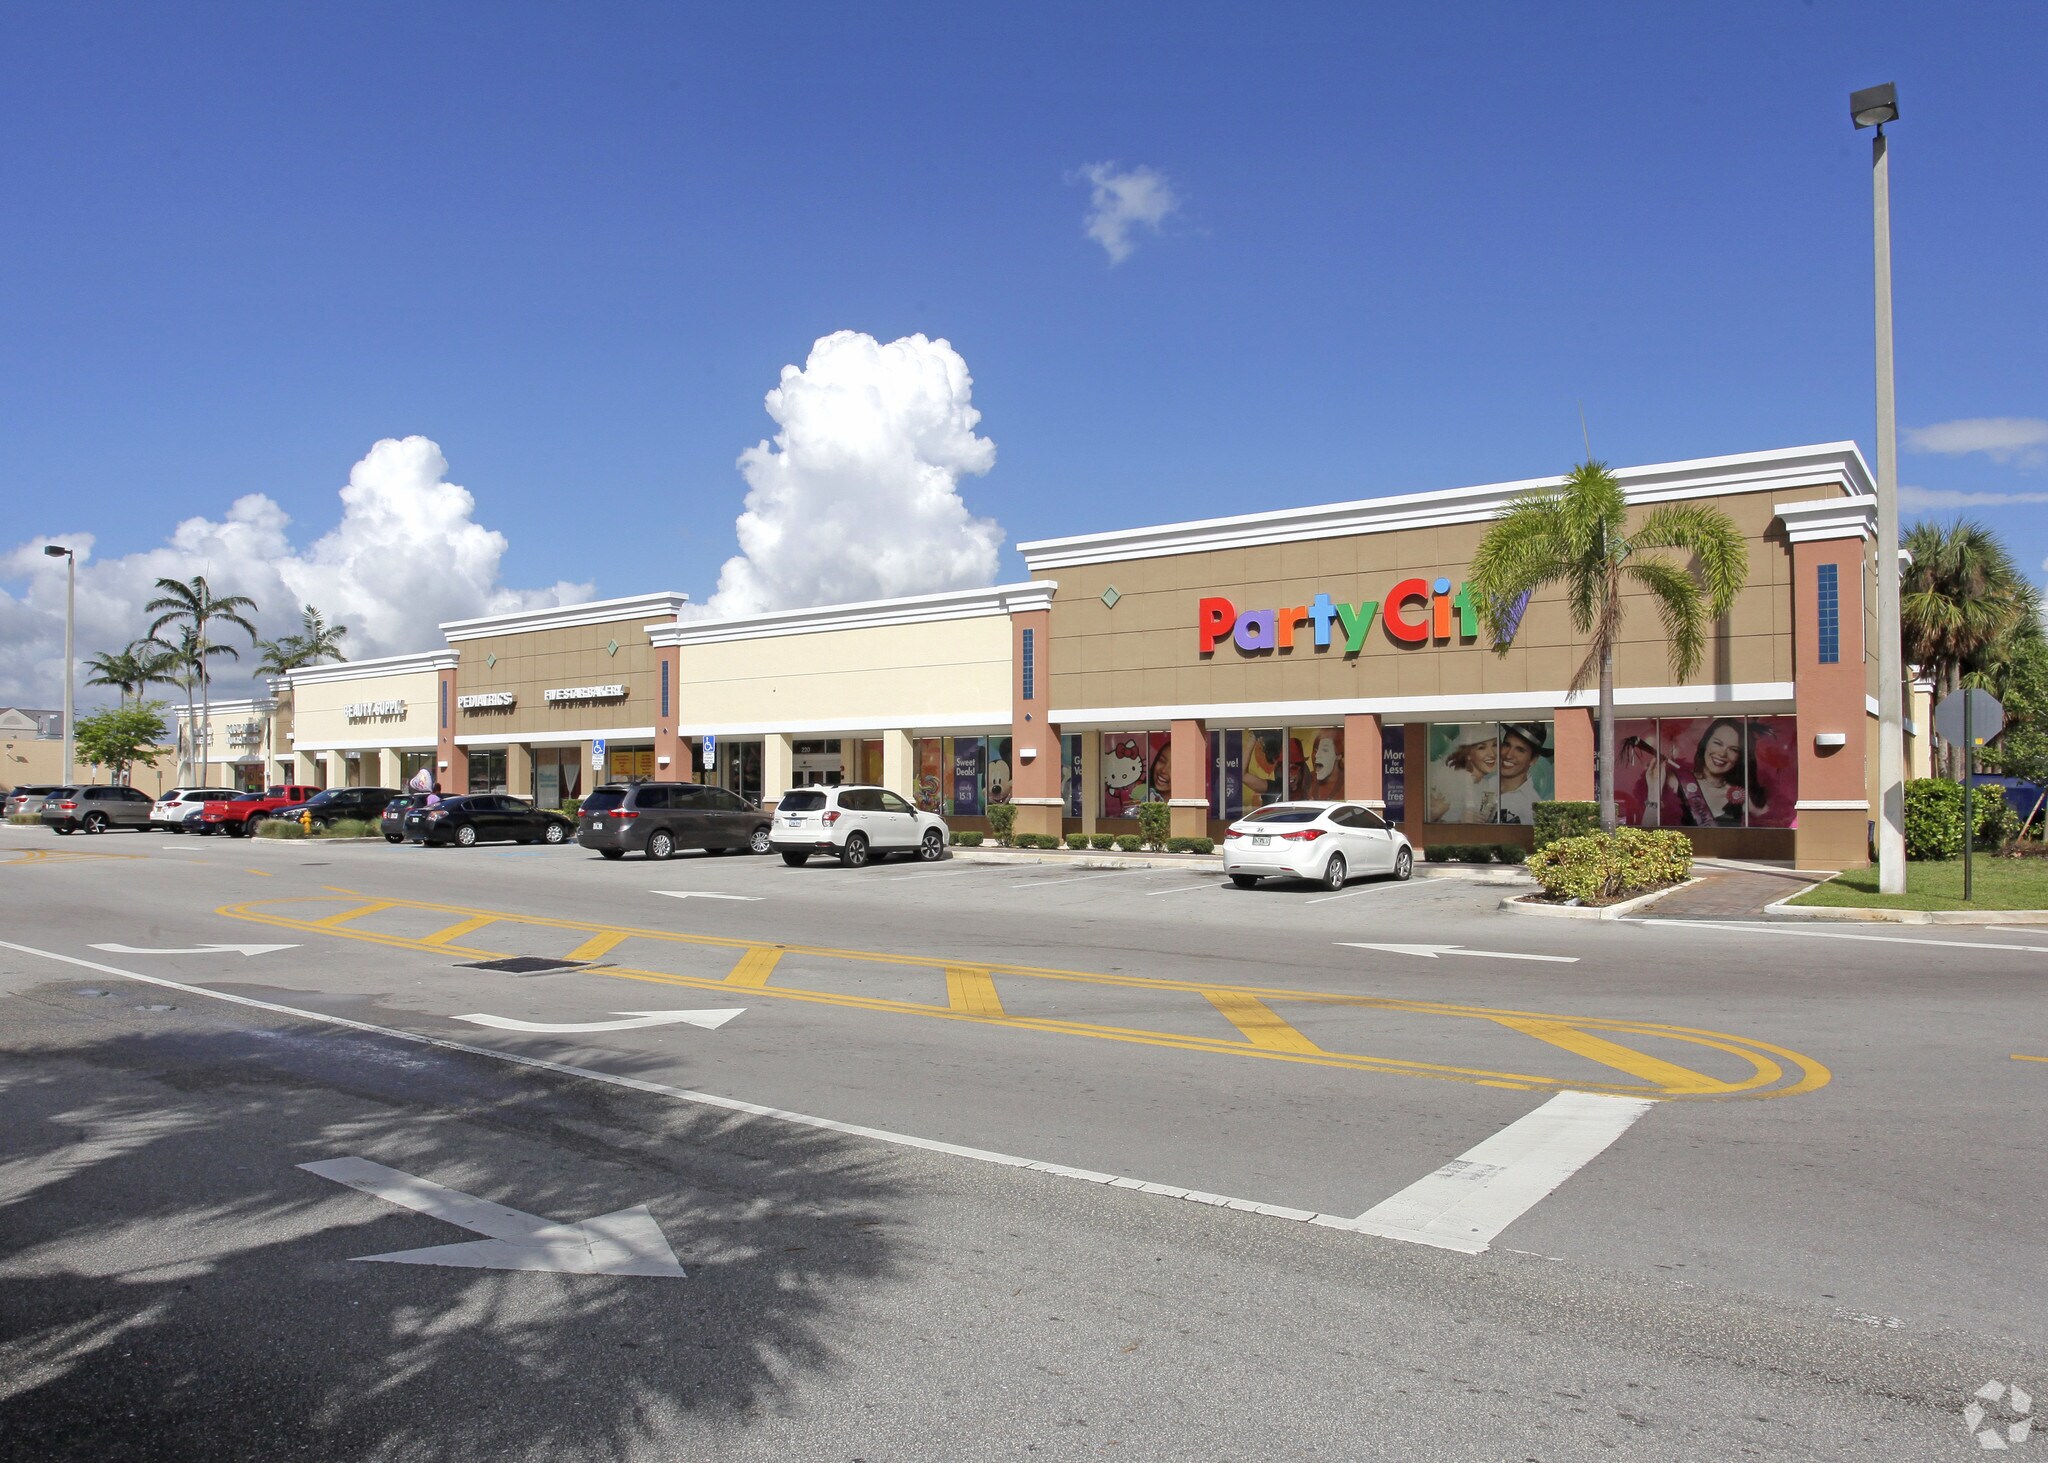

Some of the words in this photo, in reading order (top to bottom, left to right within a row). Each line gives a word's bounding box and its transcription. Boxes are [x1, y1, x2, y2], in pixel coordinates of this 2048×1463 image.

[1199, 593, 1379, 652] Party
[457, 692, 513, 708] PEDIATRICS
[344, 702, 374, 717] BEAUTY
[374, 700, 405, 715] SUPPLY
[956, 758, 976, 766] Sweet
[1216, 758, 1239, 768] Sve!
[956, 768, 976, 776] Deals!
[1385, 764, 1403, 774] Less
[1387, 791, 1404, 801] free
